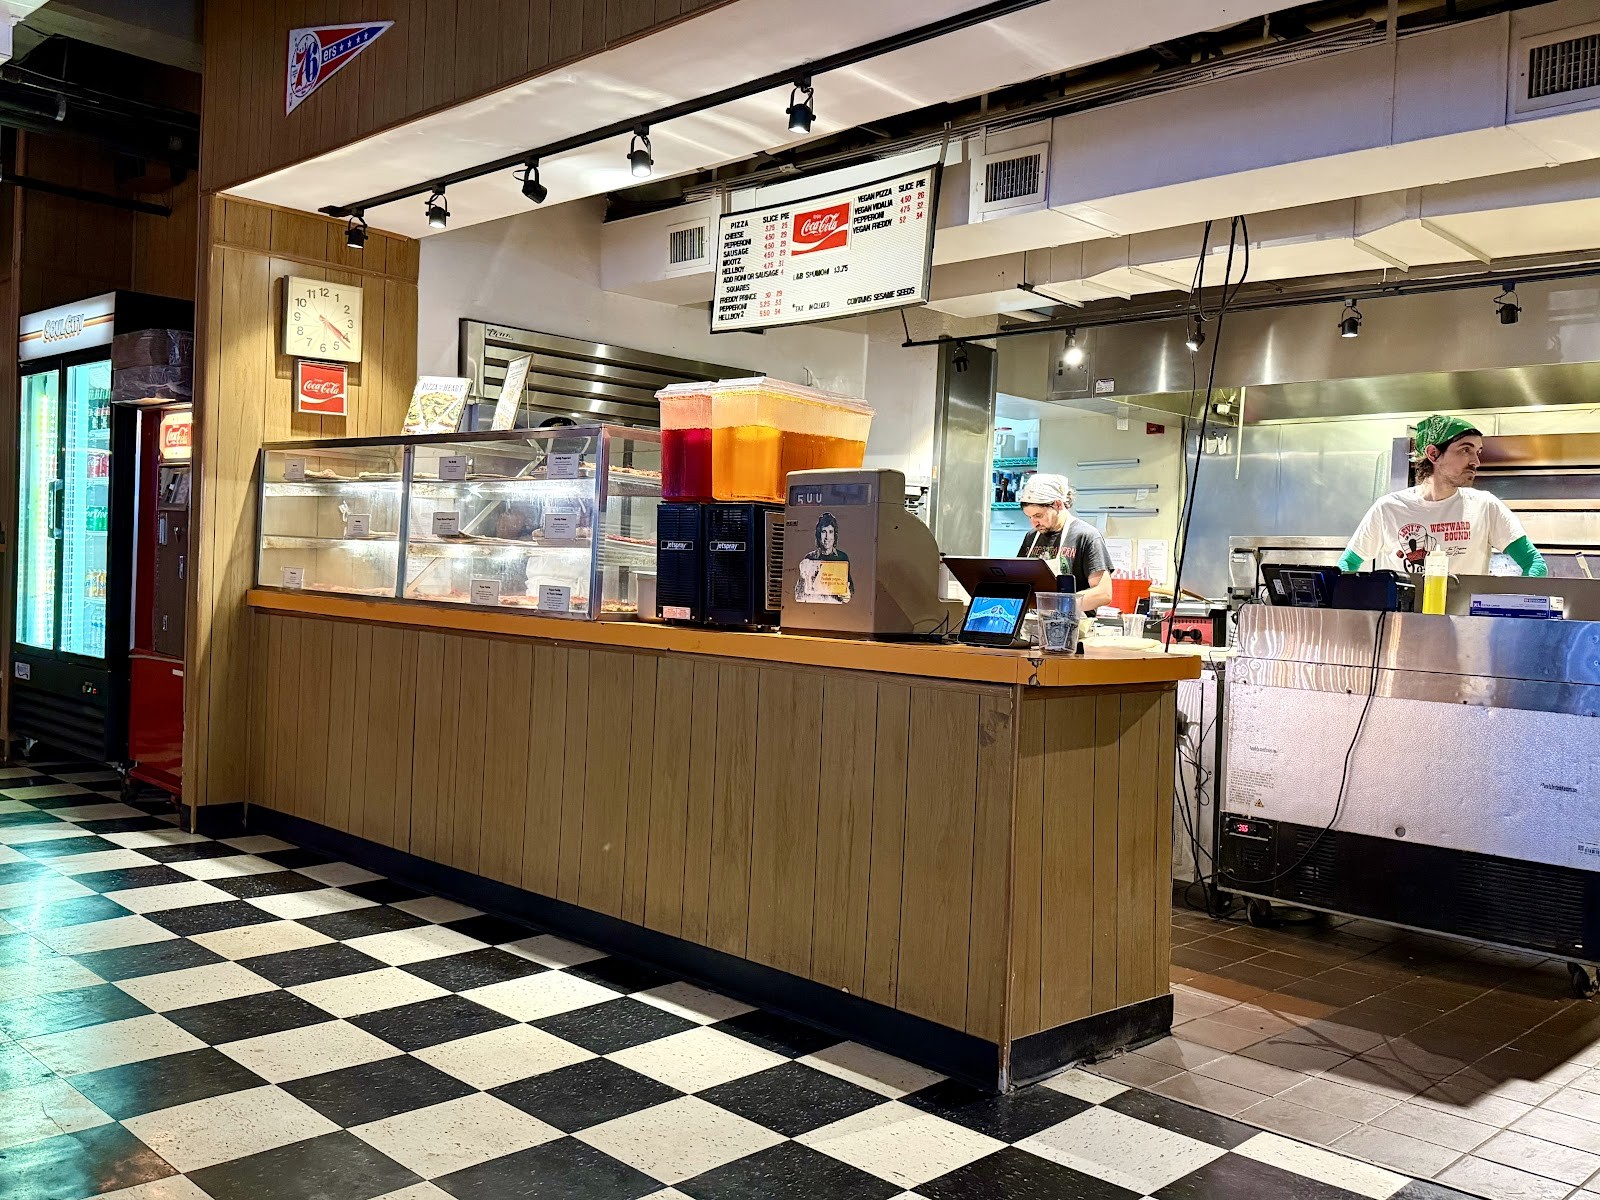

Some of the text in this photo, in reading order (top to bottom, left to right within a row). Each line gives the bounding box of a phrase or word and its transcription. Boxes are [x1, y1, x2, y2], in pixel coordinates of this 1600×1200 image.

[858, 179, 926, 203] VEGAN PIZZA SLICE PIE
[855, 205, 872, 215] VEGAN
[873, 199, 893, 211] VIDALIA
[731, 212, 790, 229] PIZZA SLICE PIE
[854, 211, 884, 224] PEPPERONI
[853, 224, 870, 234] VEGAN
[872, 219, 892, 230] FREDDY
[725, 231, 744, 240] CHEESE
[724, 239, 751, 249] PEPPERONI
[723, 248, 749, 257] SAUSAGE
[722, 266, 745, 275] HELLBOY
[734, 274, 746, 282] RONI
[755, 269, 779, 279] SAUSAGE
[319, 288, 330, 298] 12
[726, 284, 750, 293] SQUARES
[307, 289, 316, 299] 11
[719, 296, 738, 304] FREDDY
[739, 293, 757, 302] PRINCE
[847, 287, 915, 305] CONTAINS SESAME SEEDS
[295, 298, 307, 308] 10
[719, 303, 747, 312] PEPPERONI
[344, 305, 350, 314] 2
[294, 312, 301, 321] 9
[65, 313, 85, 335] CITY
[347, 320, 354, 329] 3
[297, 326, 304, 336] 8
[307, 338, 312, 347] 7
[320, 343, 327, 352] 6
[333, 341, 339, 351] 5
[304, 380, 340, 395] Coca-Cola
[422, 382, 438, 391] PIZZA
[443, 384, 464, 393] HEART
[1400, 525, 1421, 538] LEVI'S
[1430, 521, 1471, 533] WESTWARD
[1444, 531, 1471, 541] BOUND!
[717, 542, 739, 551] jetspray
